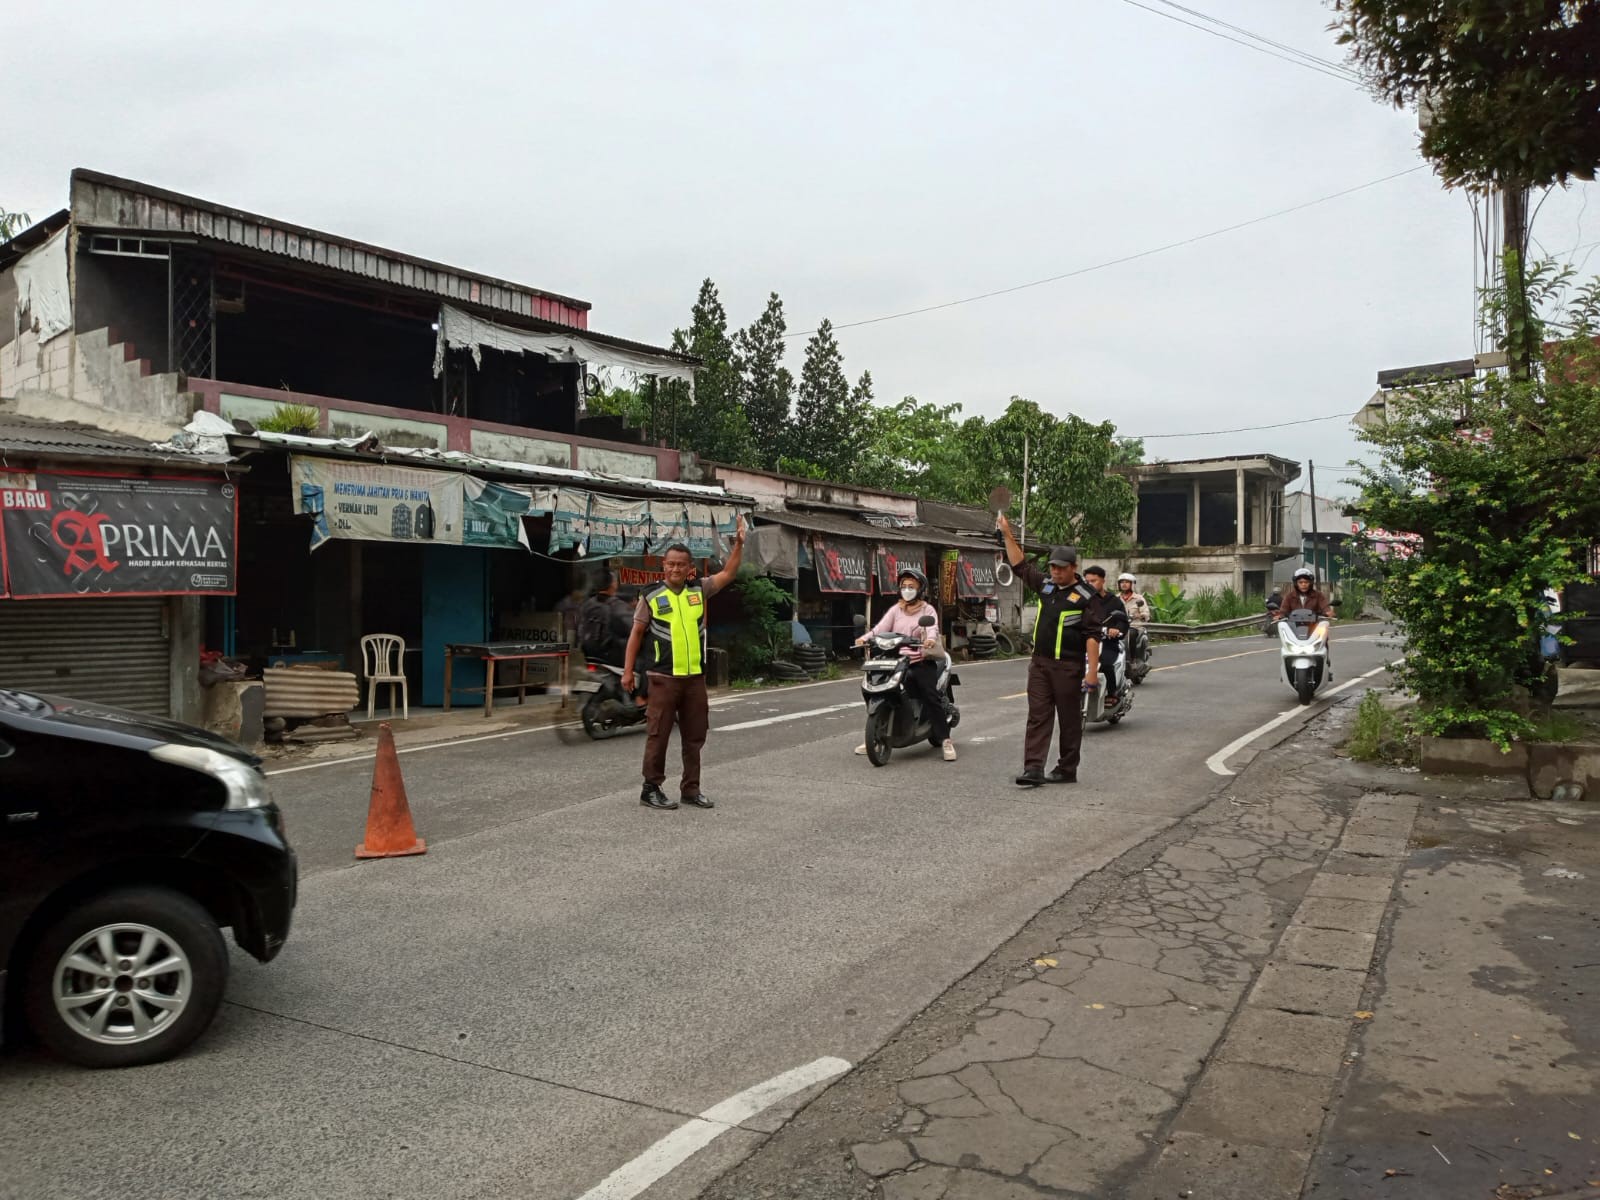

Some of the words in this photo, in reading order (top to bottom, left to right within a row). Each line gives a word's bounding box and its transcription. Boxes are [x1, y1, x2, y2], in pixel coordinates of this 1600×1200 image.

[3, 490, 46, 508] BARU
[334, 482, 365, 497] MENERIMA
[367, 485, 390, 499] JAHITAN
[391, 487, 403, 500] PRIA
[338, 502, 362, 514] VERMAK
